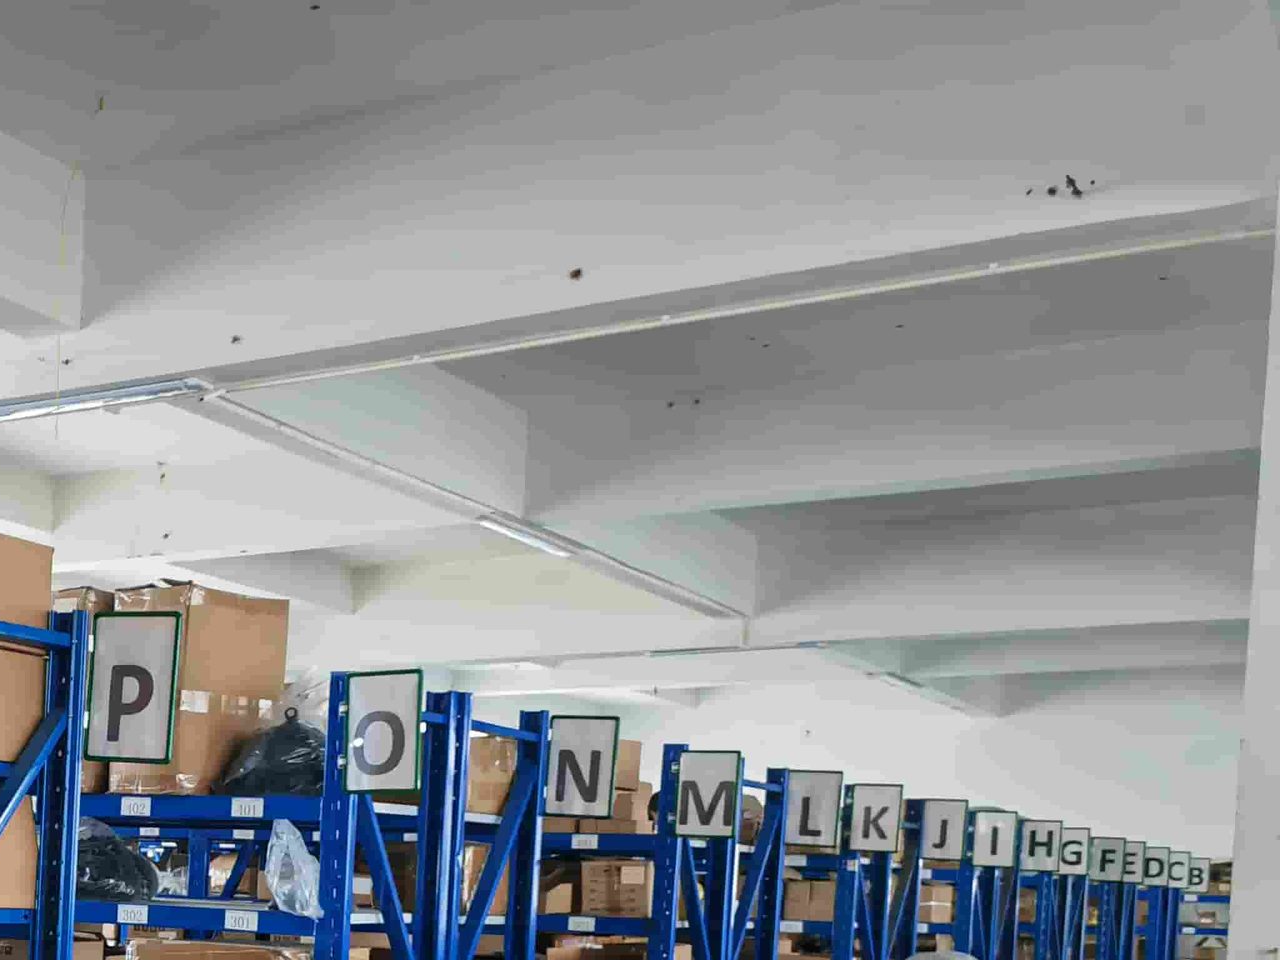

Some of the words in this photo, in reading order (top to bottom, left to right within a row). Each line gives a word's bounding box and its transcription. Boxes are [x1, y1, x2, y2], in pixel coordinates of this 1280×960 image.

[107, 664, 154, 742] P
[353, 710, 405, 775] O
[555, 750, 602, 803] N
[679, 780, 737, 826] M
[799, 797, 822, 837] L
[862, 806, 890, 840] K
[932, 819, 949, 849] J
[990, 826, 999, 856] I
[1028, 829, 1054, 857] H
[1060, 840, 1083, 865] G
[1099, 849, 1117, 872] F
[1123, 852, 1138, 875] E
[1144, 857, 1164, 878] D
[1169, 861, 1186, 882] C
[1189, 867, 1204, 886] B
[230, 915, 251, 930] 301
